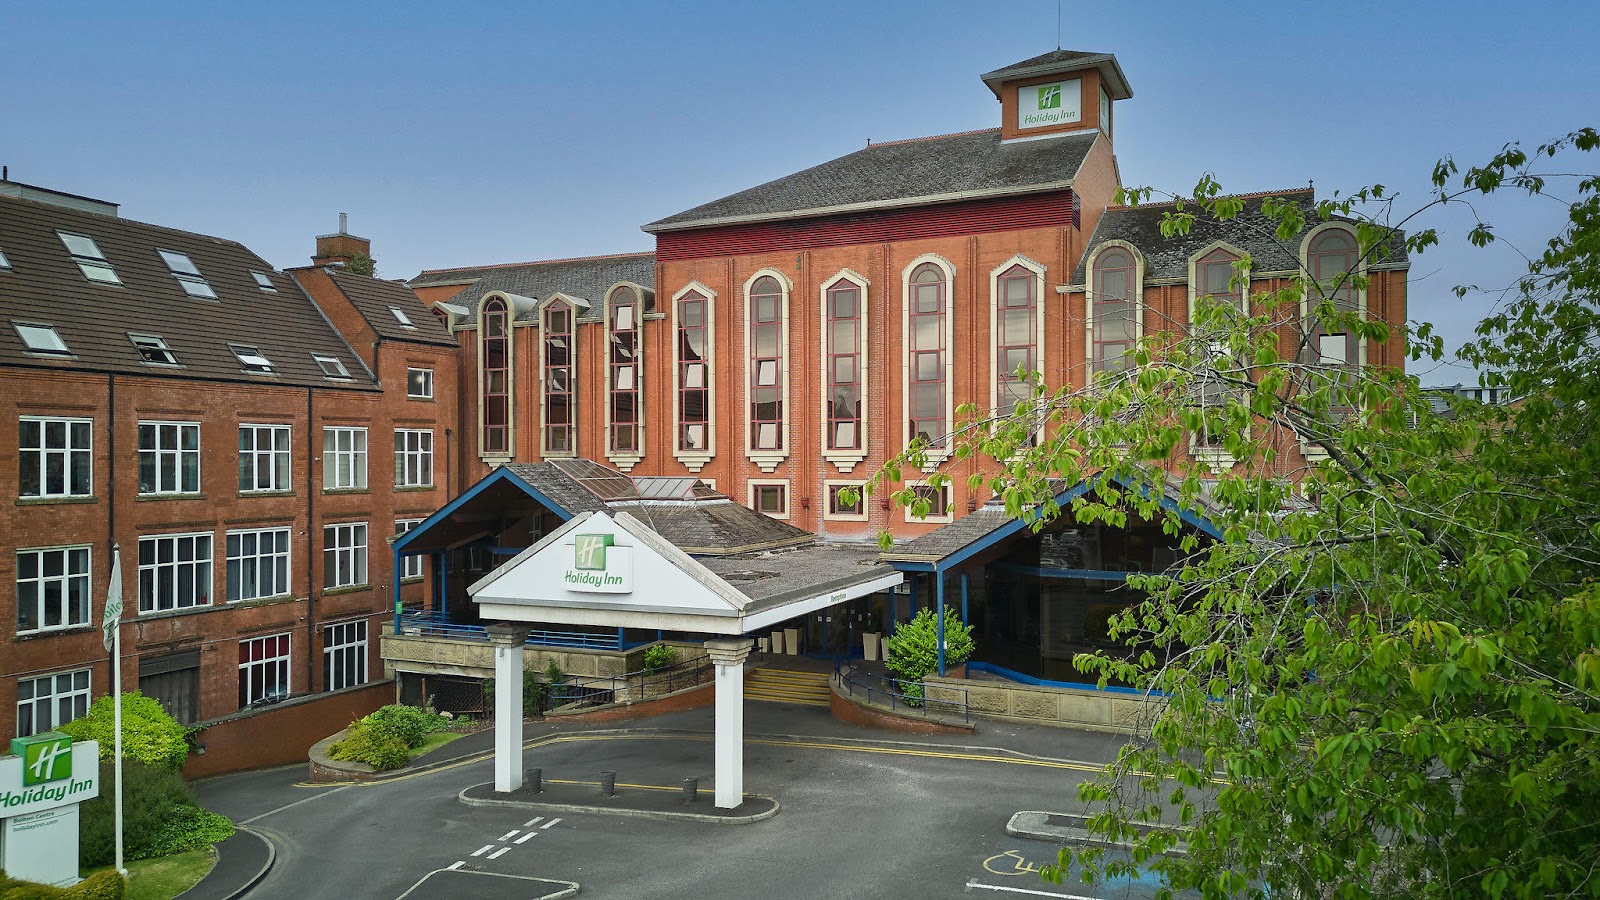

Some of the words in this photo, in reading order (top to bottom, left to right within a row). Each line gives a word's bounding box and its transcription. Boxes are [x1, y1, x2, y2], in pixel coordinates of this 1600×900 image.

[1024, 111, 1059, 124] Holiday
[1060, 110, 1075, 119] Inn
[565, 570, 602, 587] Holiday
[603, 572, 623, 585] Inn
[0, 786, 66, 808] Holiday
[68, 778, 93, 795] Inn
[13, 815, 34, 824] Bolton
[35, 811, 55, 819] Centre
[13, 819, 58, 832] holidayinn.com
